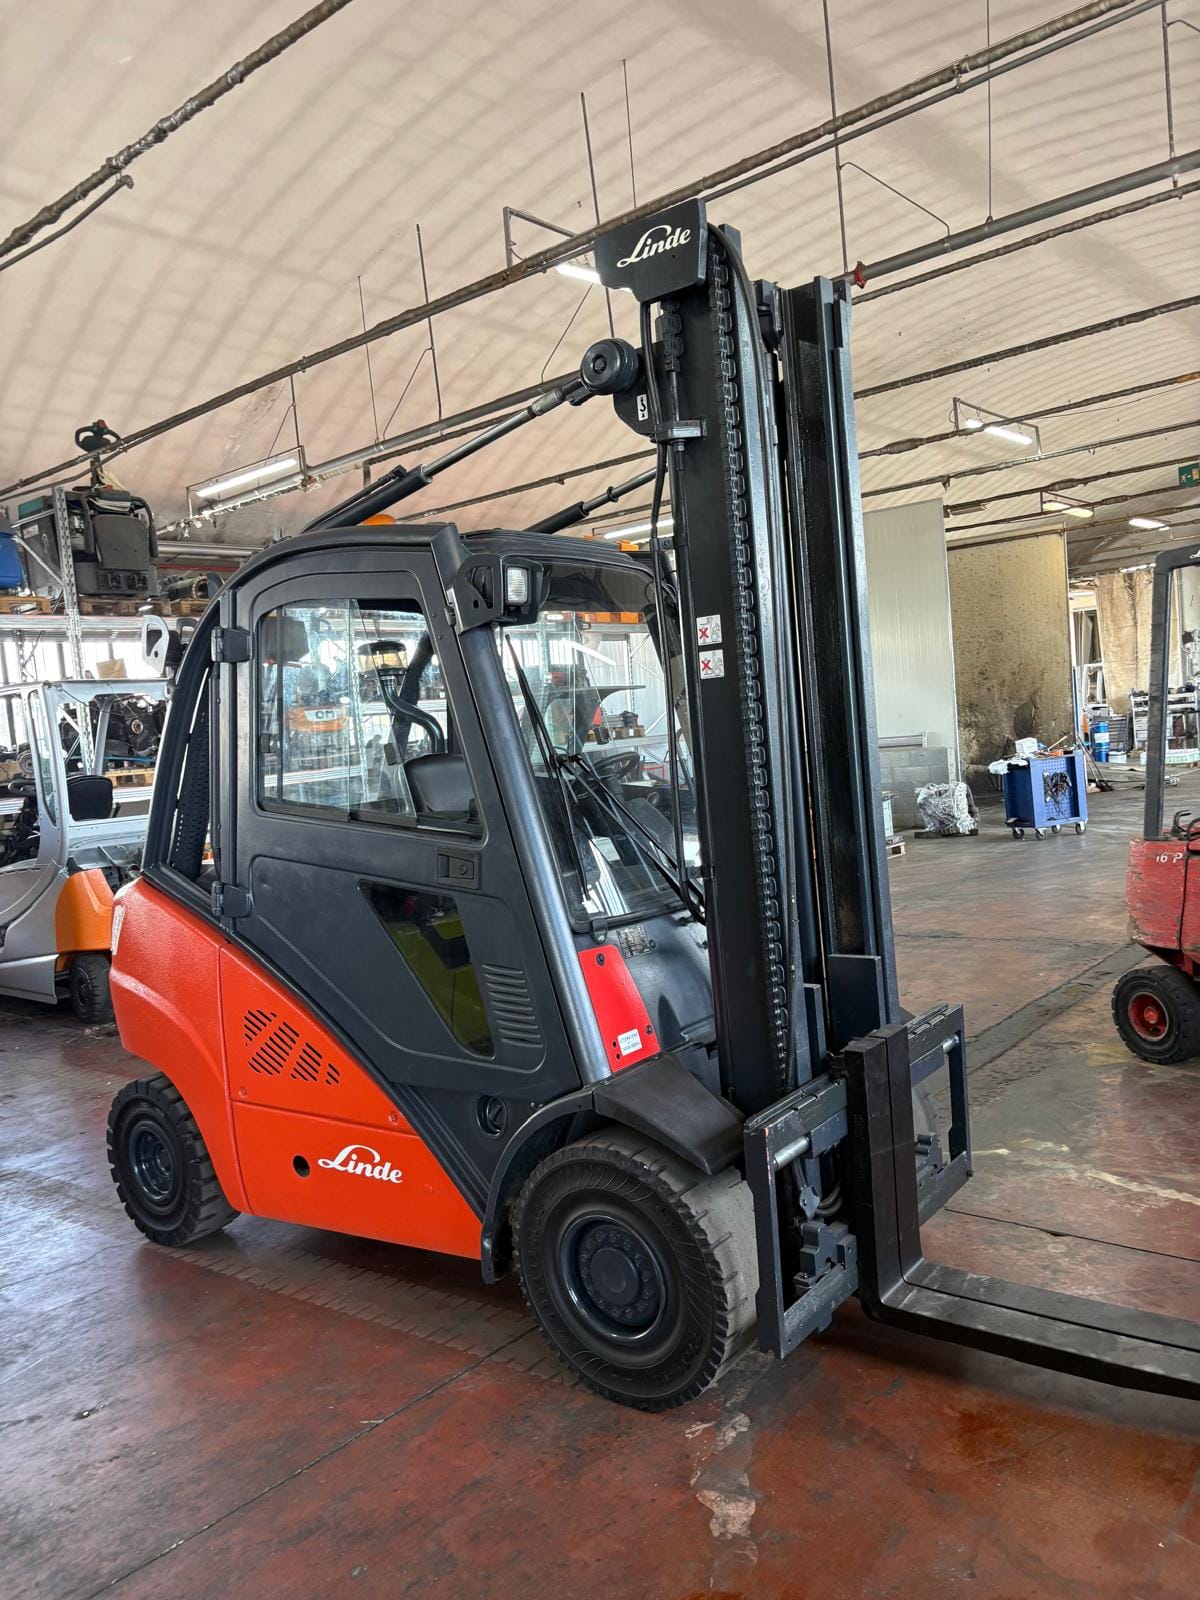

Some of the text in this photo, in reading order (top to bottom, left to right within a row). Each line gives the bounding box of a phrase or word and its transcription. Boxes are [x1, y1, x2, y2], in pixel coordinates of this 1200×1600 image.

[616, 225, 691, 267] Linde
[315, 710, 335, 720] OM
[317, 1144, 403, 1184] Linde
